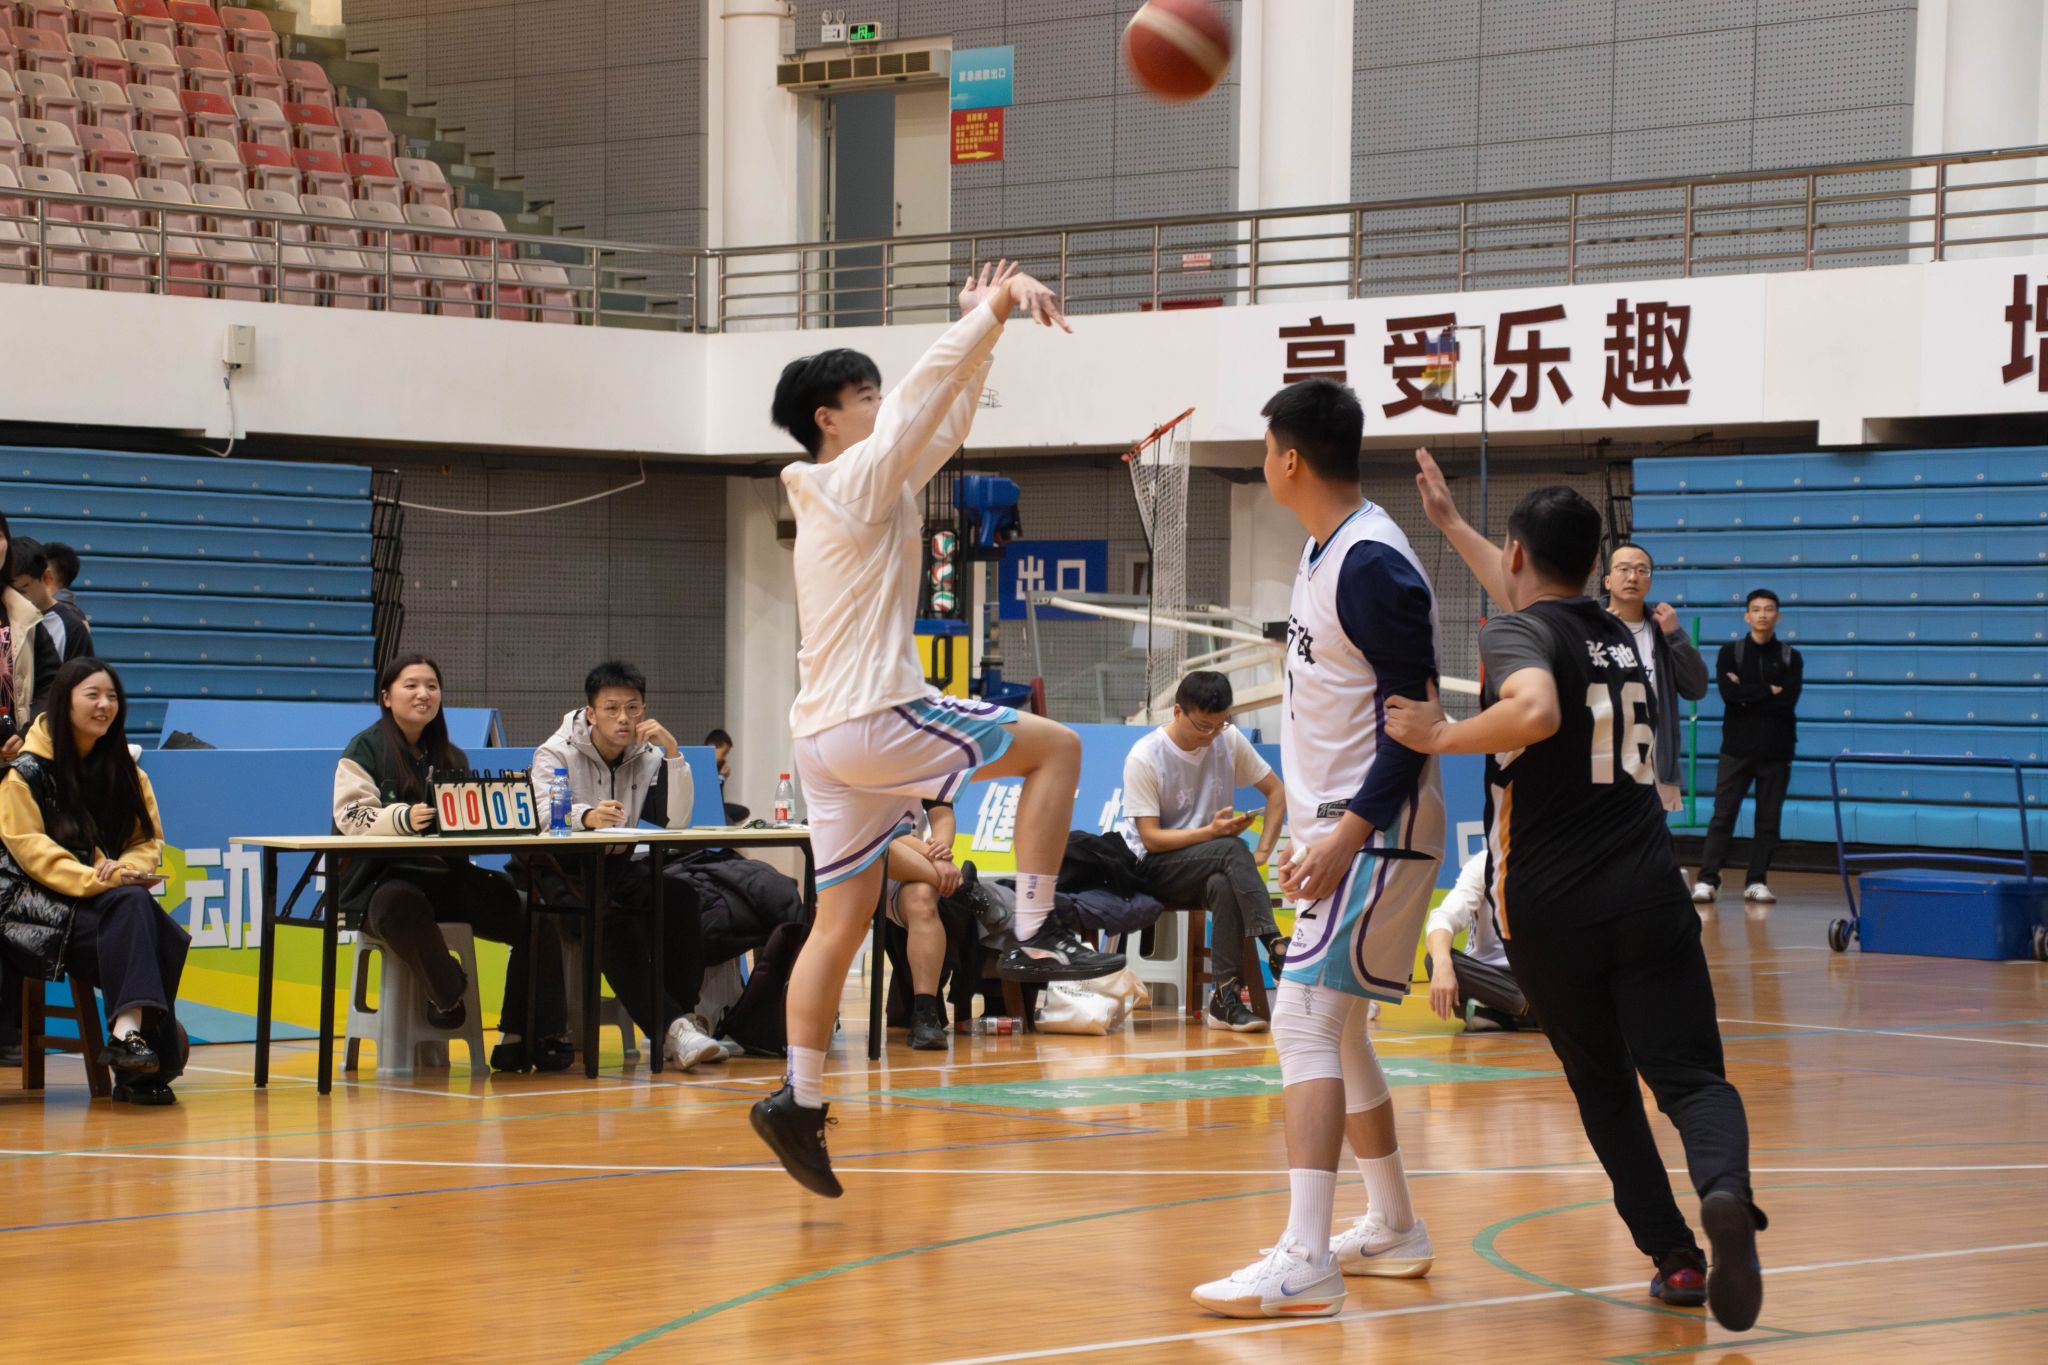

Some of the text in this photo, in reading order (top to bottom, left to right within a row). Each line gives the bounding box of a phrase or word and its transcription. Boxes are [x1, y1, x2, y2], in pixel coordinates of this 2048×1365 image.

[1279, 298, 1691, 418] 享受乐趣
[1016, 554, 1086, 601] 出口
[1585, 681, 1655, 785] 16
